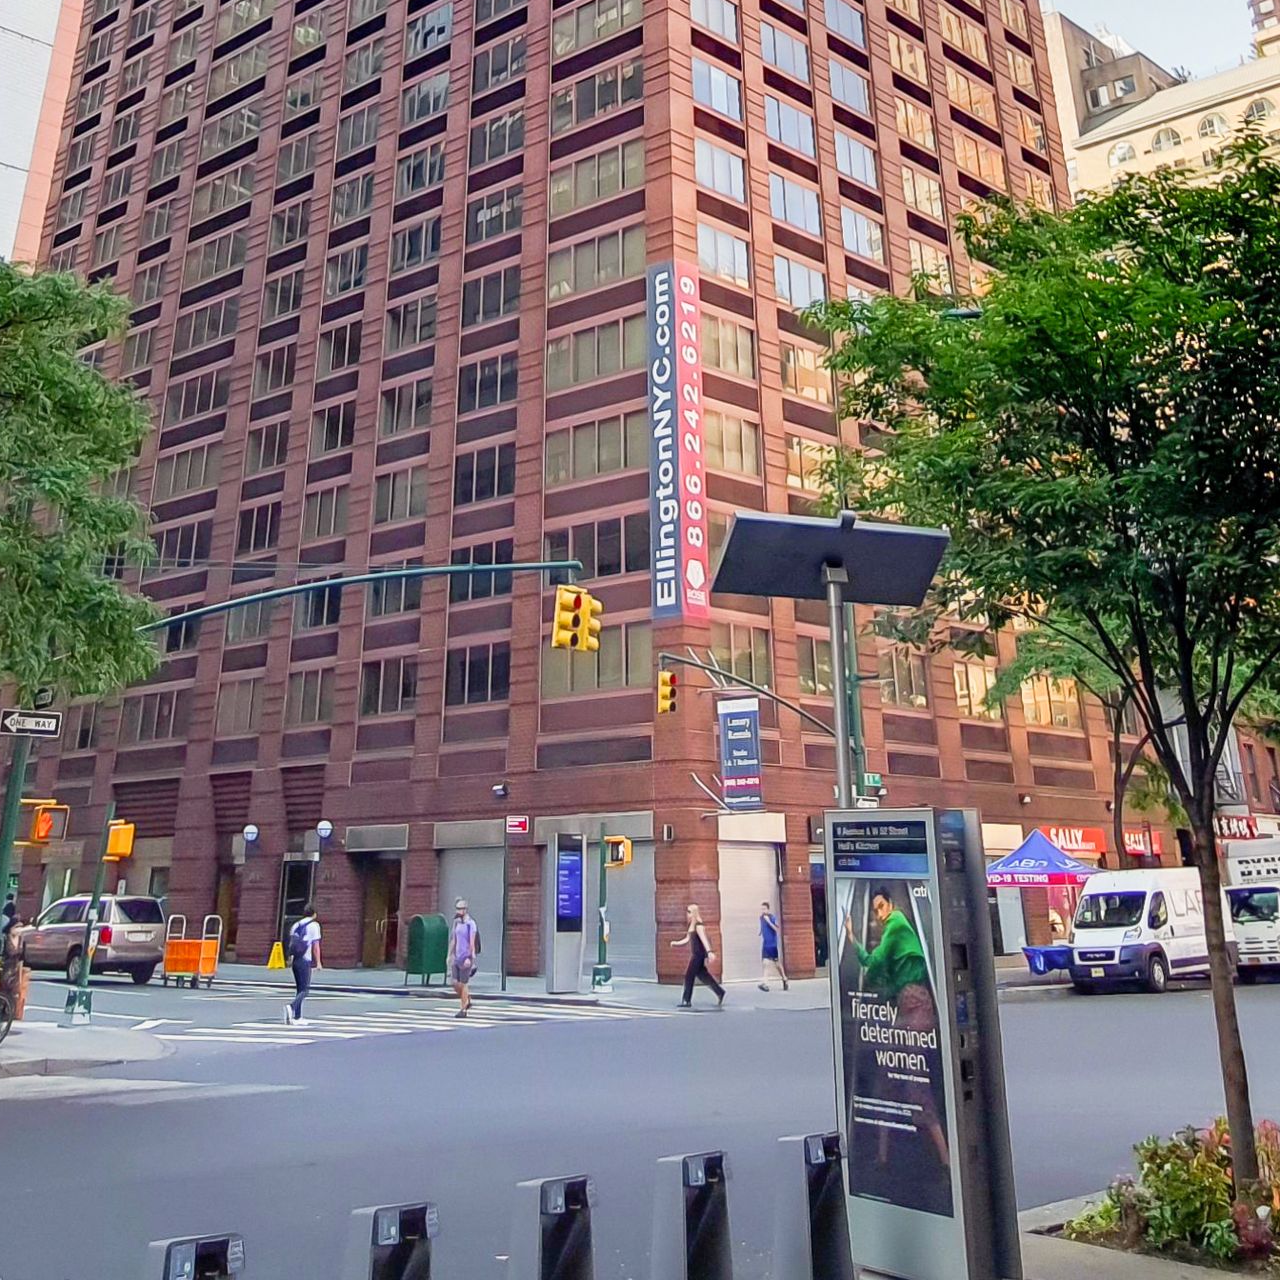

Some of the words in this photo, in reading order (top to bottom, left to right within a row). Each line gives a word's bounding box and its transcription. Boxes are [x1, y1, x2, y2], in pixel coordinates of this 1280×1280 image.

[681, 276, 704, 548] 866.242.6219
[652, 271, 679, 608] EllingtonNYC.com
[9, 717, 27, 728] ONE
[34, 720, 53, 729] WAY
[1050, 827, 1084, 850] SALLY
[985, 874, 1012, 883] VID-19
[1014, 874, 1049, 883] TESTING
[851, 998, 898, 1025] fiercely
[860, 1022, 937, 1049] determined
[875, 1050, 930, 1072] women.
